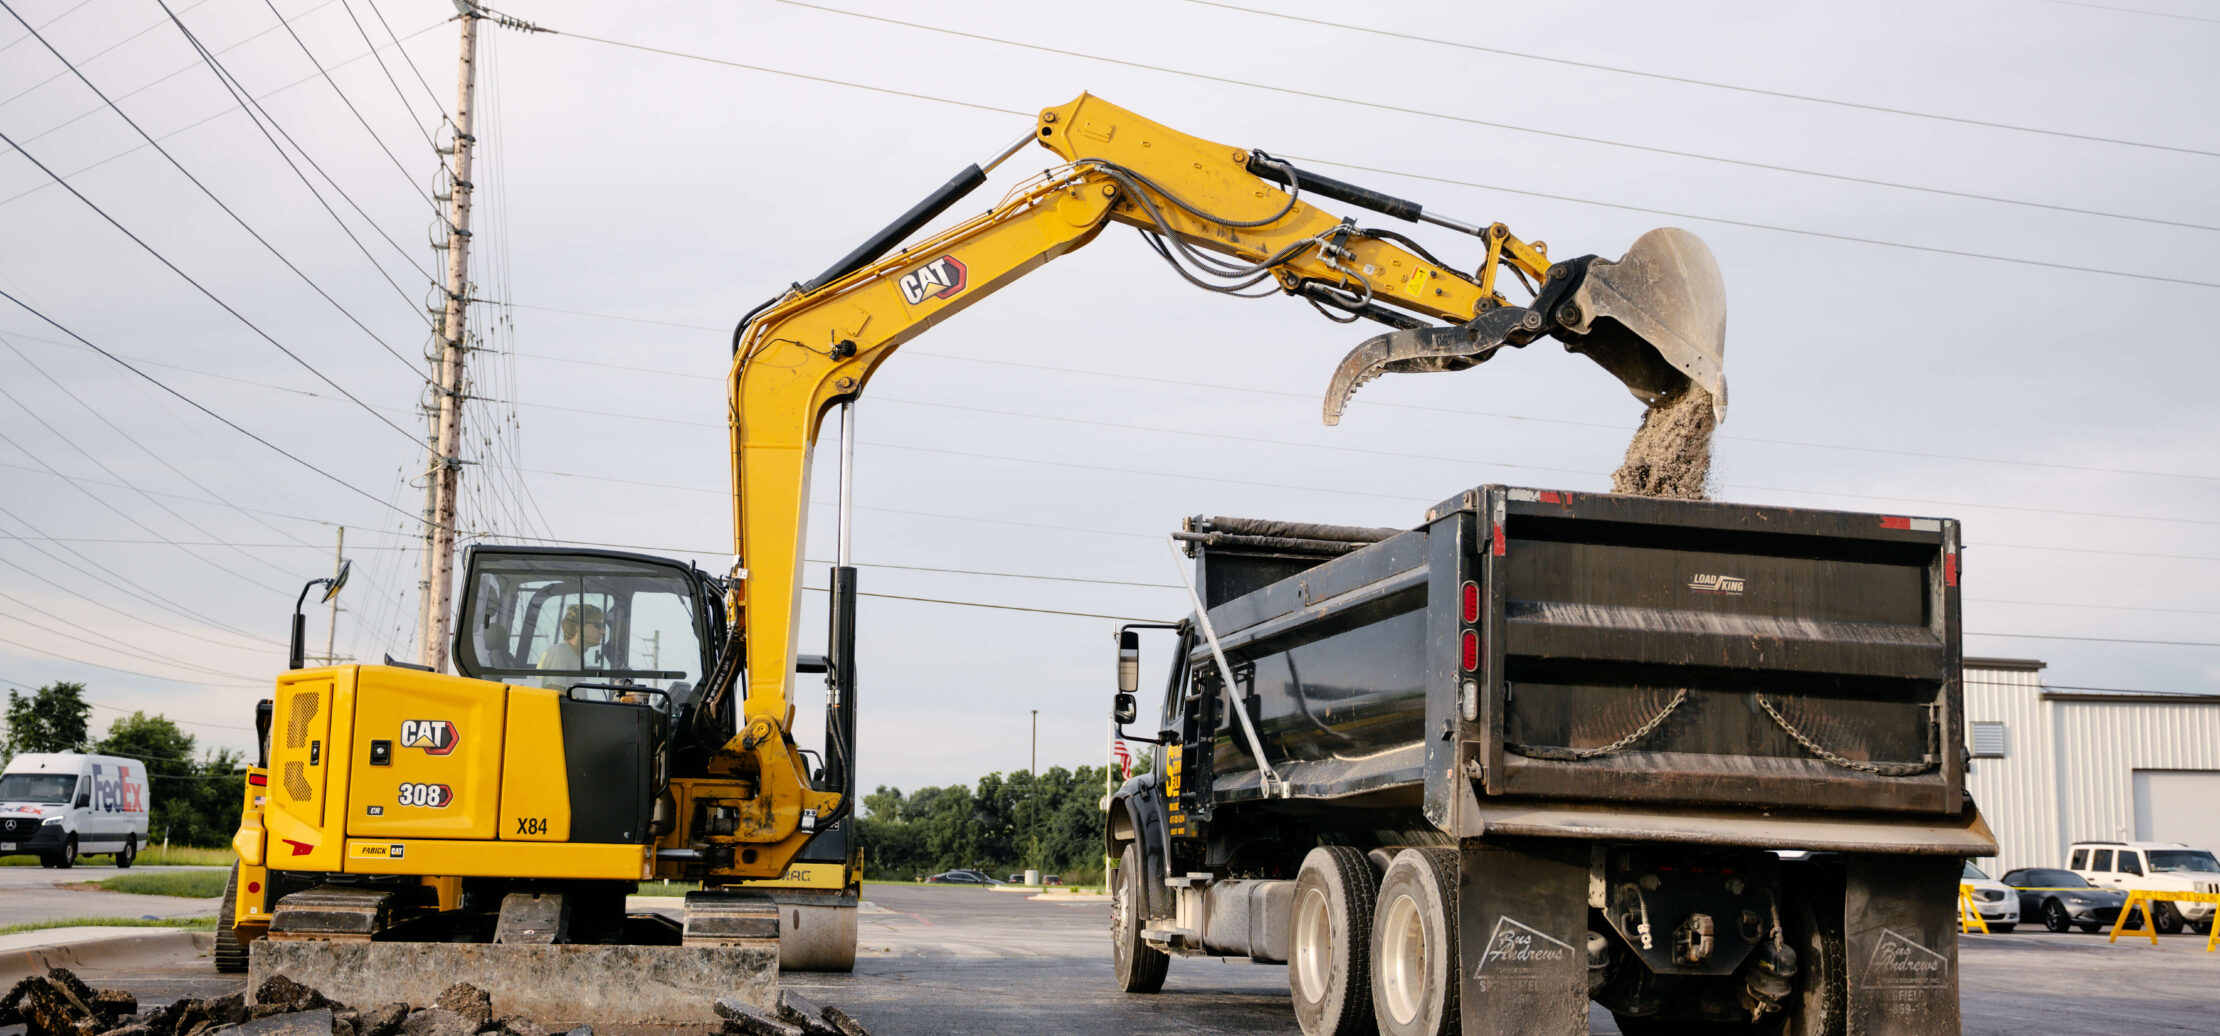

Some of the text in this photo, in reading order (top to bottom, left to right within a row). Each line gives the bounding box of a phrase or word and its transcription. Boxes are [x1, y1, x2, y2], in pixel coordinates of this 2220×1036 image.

[899, 257, 952, 305] CAT
[1694, 574, 1744, 592] LOAD KING
[401, 719, 446, 748] CAT
[92, 763, 144, 813] FedEx
[399, 783, 442, 806] 308
[0, 804, 43, 815] edEx
[370, 807, 381, 815] CR
[516, 817, 548, 835] X84
[361, 846, 403, 855] FABICK CAT
[1498, 929, 1532, 948] Bus
[1489, 945, 1564, 962] Andrews
[1881, 941, 1911, 958] Bus
[1872, 955, 1938, 972] Andrews
